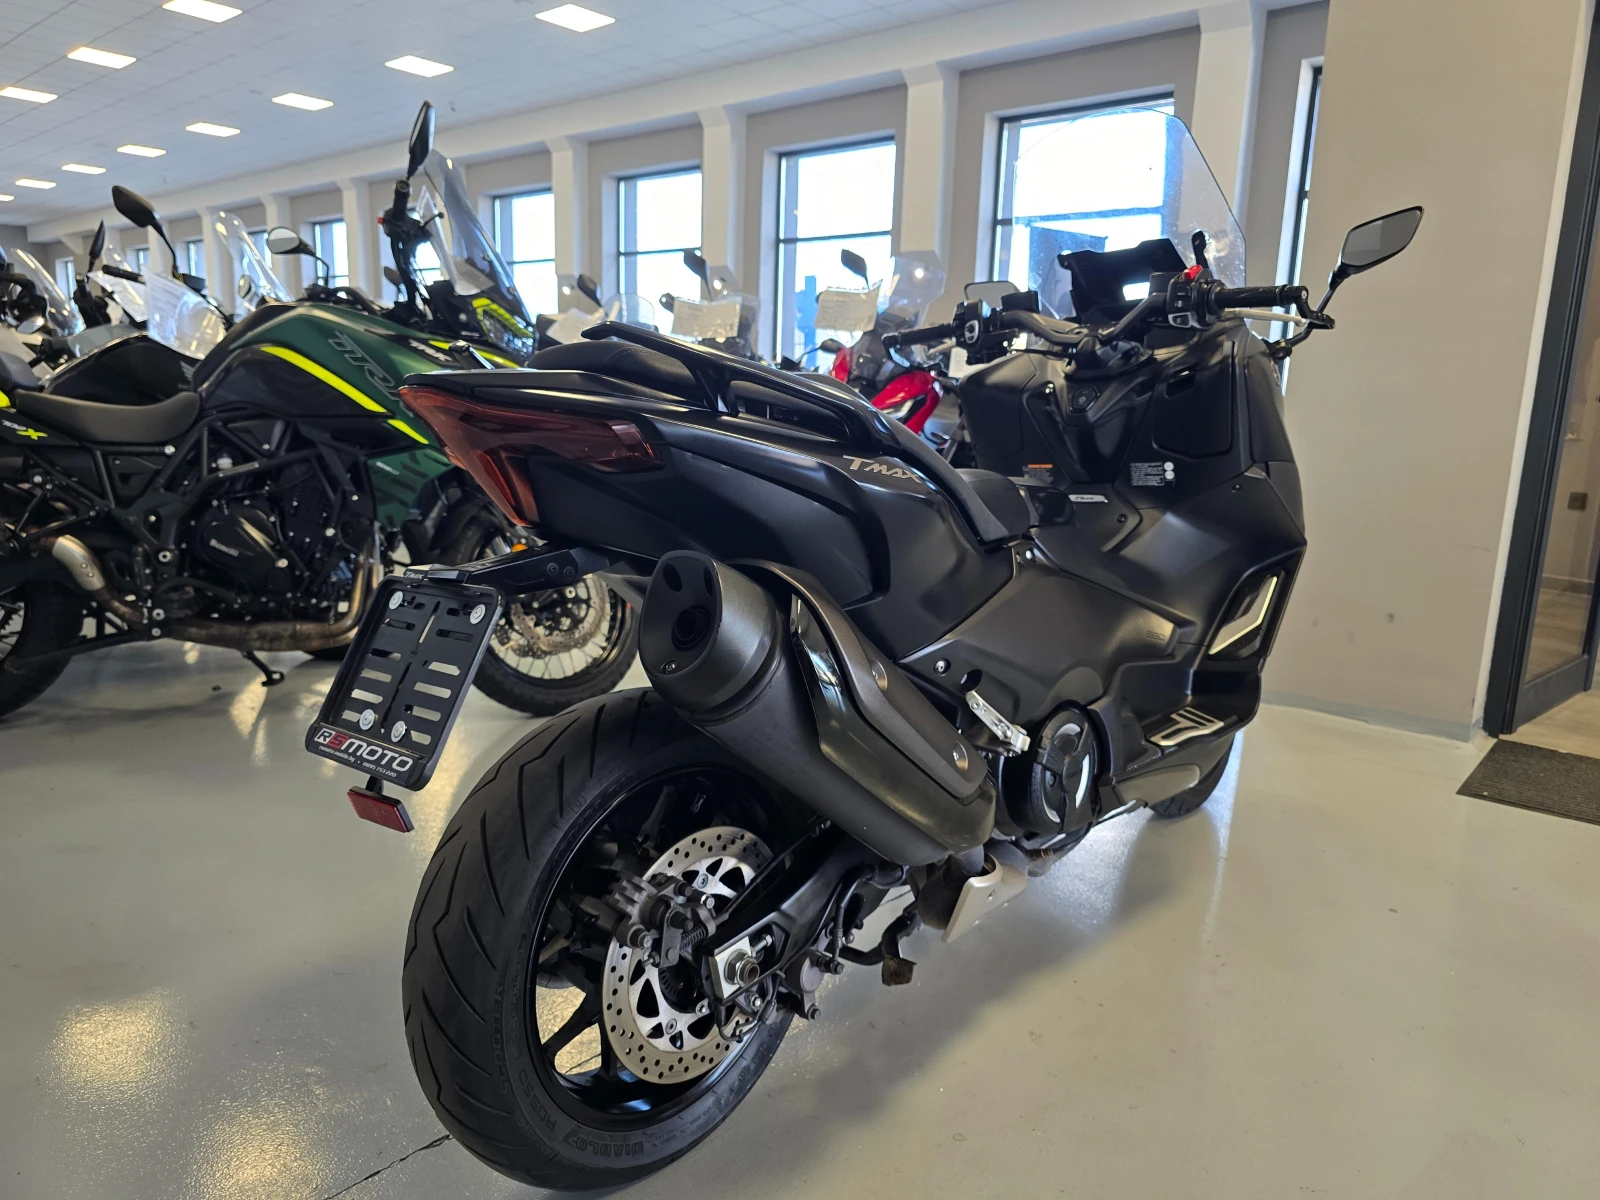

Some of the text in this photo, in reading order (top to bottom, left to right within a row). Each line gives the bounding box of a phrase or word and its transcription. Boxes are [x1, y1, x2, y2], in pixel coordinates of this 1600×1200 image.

[327, 330, 414, 418] TR
[842, 454, 922, 484] TMAX
[314, 727, 414, 772] RSMOTO
[575, 1136, 645, 1158] DIABLO
